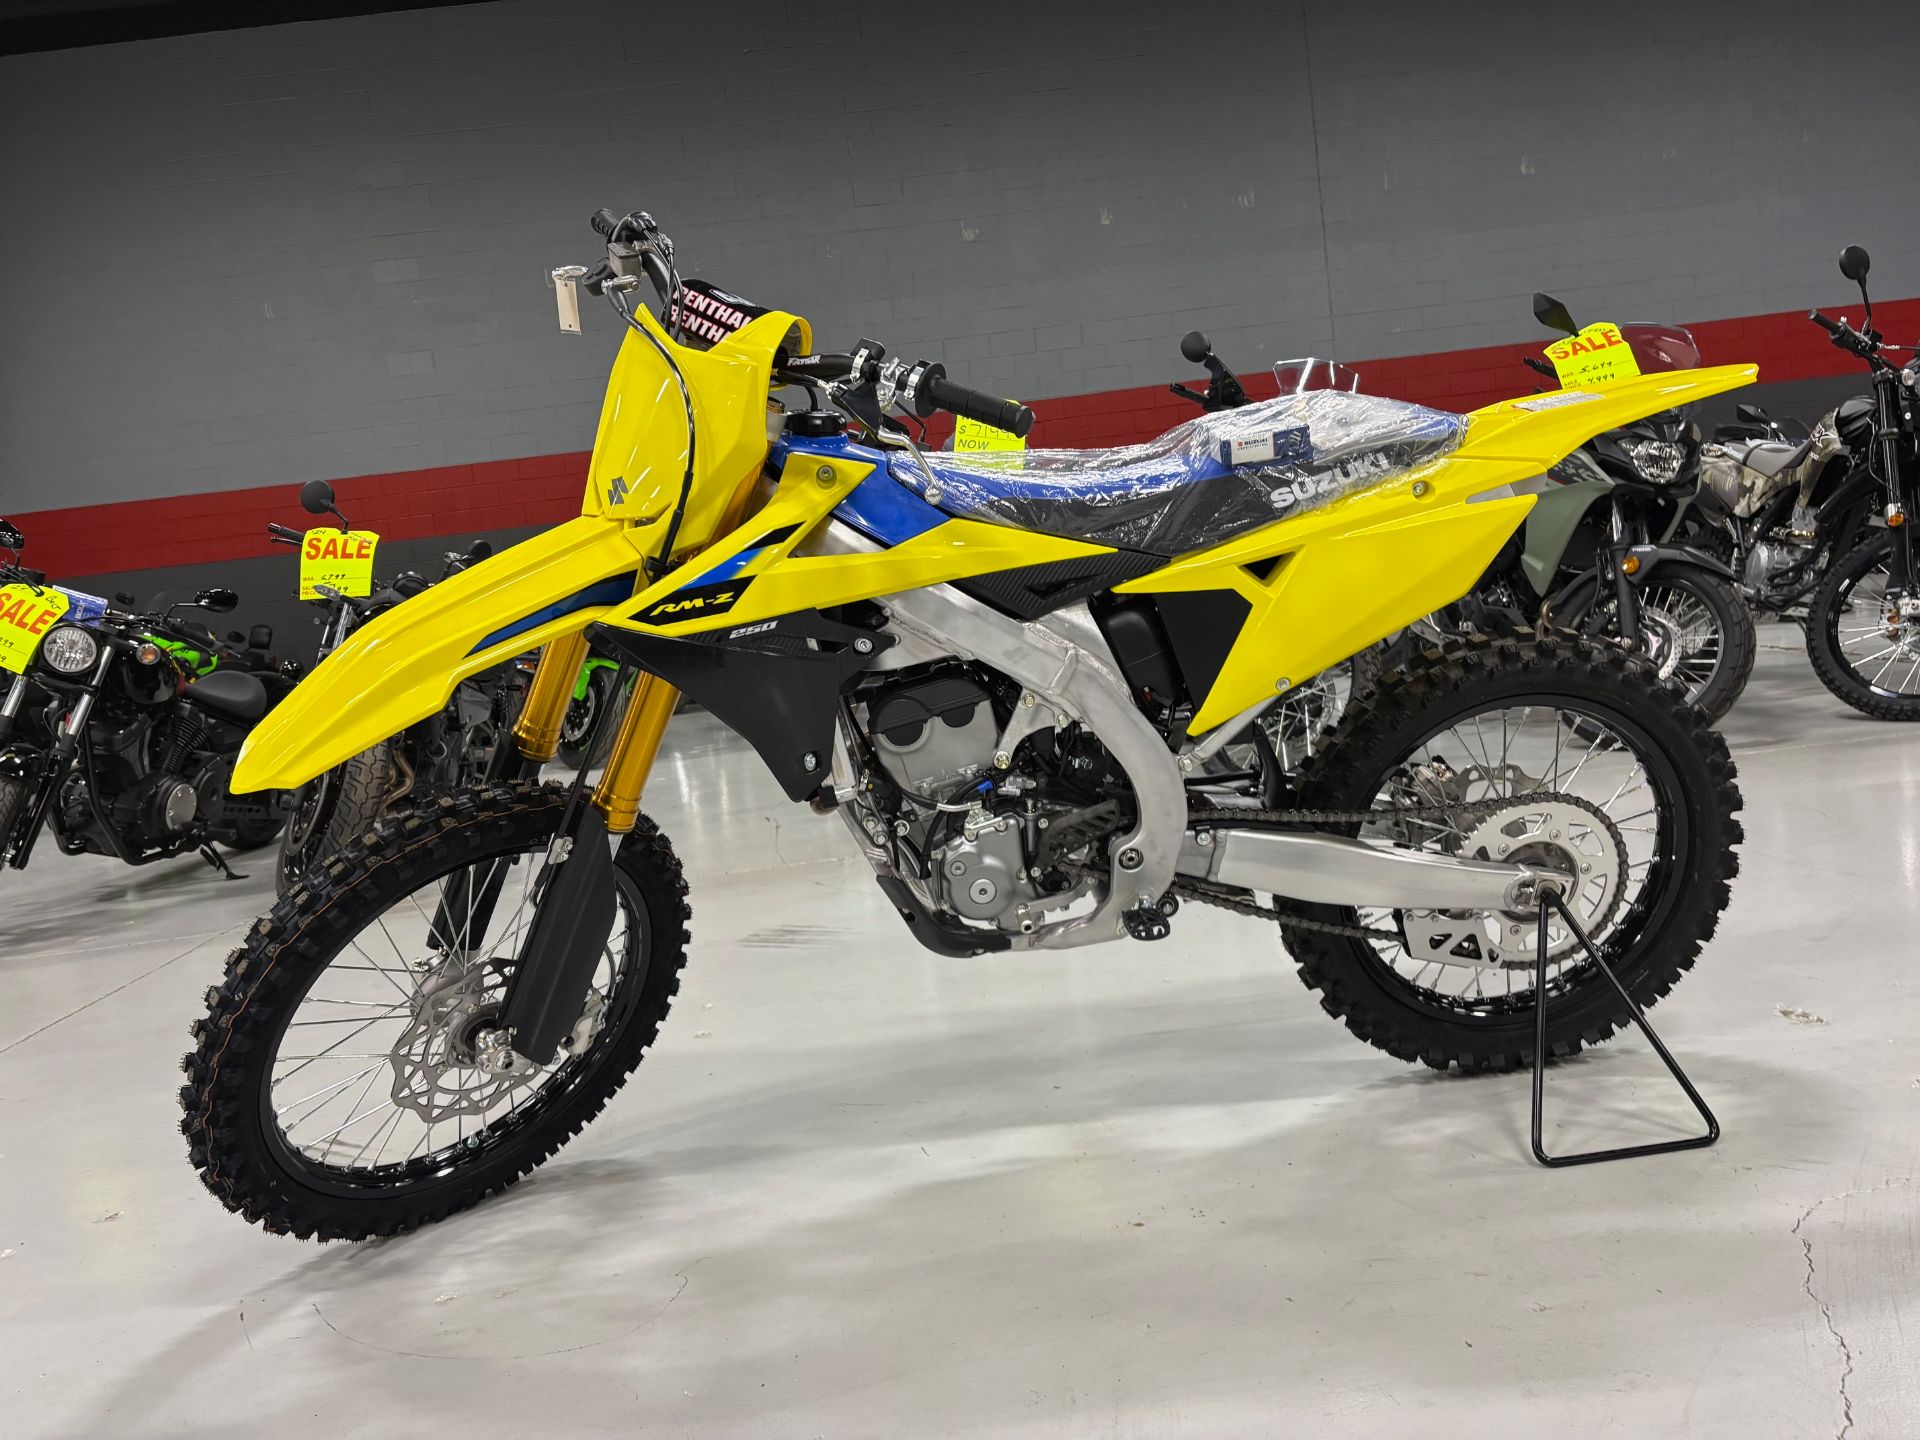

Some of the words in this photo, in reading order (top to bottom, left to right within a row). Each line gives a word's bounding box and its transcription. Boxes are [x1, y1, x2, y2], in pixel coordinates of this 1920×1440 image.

[1551, 330, 1623, 360] SALE
[957, 438, 990, 450] NOW
[1270, 451, 1390, 509] SUZUKI
[305, 537, 371, 561] SALE
[649, 591, 735, 616] RM-Z
[729, 620, 779, 639] 250
